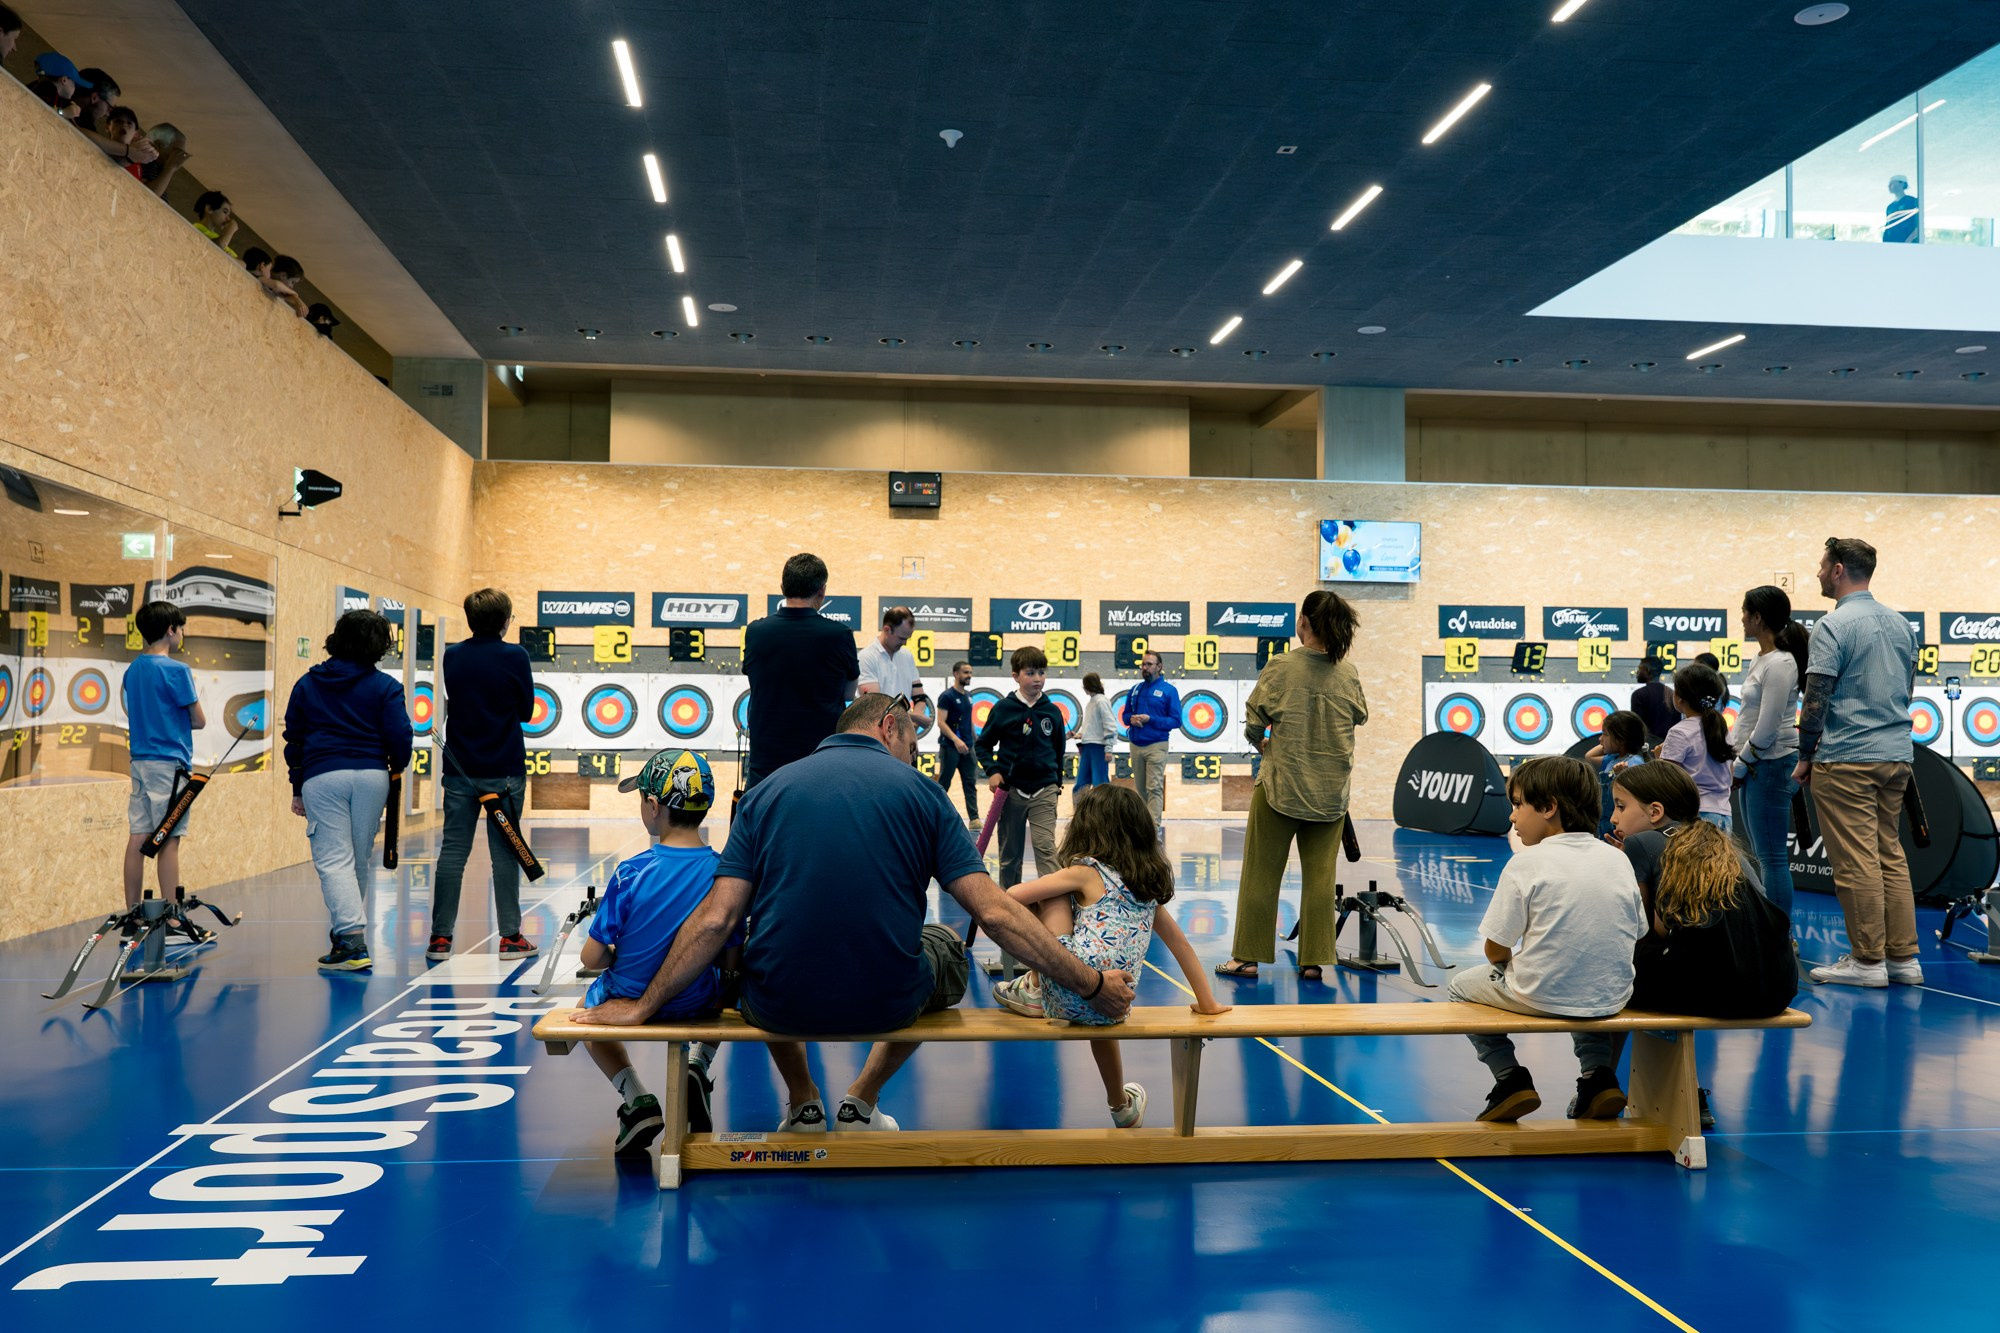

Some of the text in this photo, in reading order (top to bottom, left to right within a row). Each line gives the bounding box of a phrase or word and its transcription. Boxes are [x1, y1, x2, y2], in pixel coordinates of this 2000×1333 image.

[1781, 576, 1788, 587] 2
[542, 601, 614, 614] WIAWIS
[667, 602, 734, 613] HOYT
[883, 605, 969, 614] NVAERY
[1128, 610, 1182, 625] Logistics
[1011, 621, 1060, 631] HYUNDAI
[1468, 617, 1517, 629] vaudoise
[1664, 616, 1721, 632] YOUYI
[614, 631, 628, 658] 2
[690, 630, 704, 658] 3
[917, 636, 931, 662] 6
[989, 635, 1002, 661] 7
[1063, 637, 1077, 662] 8
[1132, 638, 1147, 666] 9
[1197, 641, 1217, 667] 10
[1458, 643, 1476, 668] 12
[1591, 645, 1609, 666] 14
[1722, 644, 1740, 668] 16
[1523, 645, 1546, 670] 13
[1656, 644, 1677, 671] 15
[1918, 646, 1938, 673] 19
[1974, 649, 2000, 673] 20
[525, 751, 551, 775] 56
[592, 755, 620, 775] 41
[1194, 755, 1221, 778] 53
[1418, 769, 1474, 804] YOUYI
[503, 818, 536, 867] EASTON
[1789, 862, 1834, 876] EAD TO VICT
